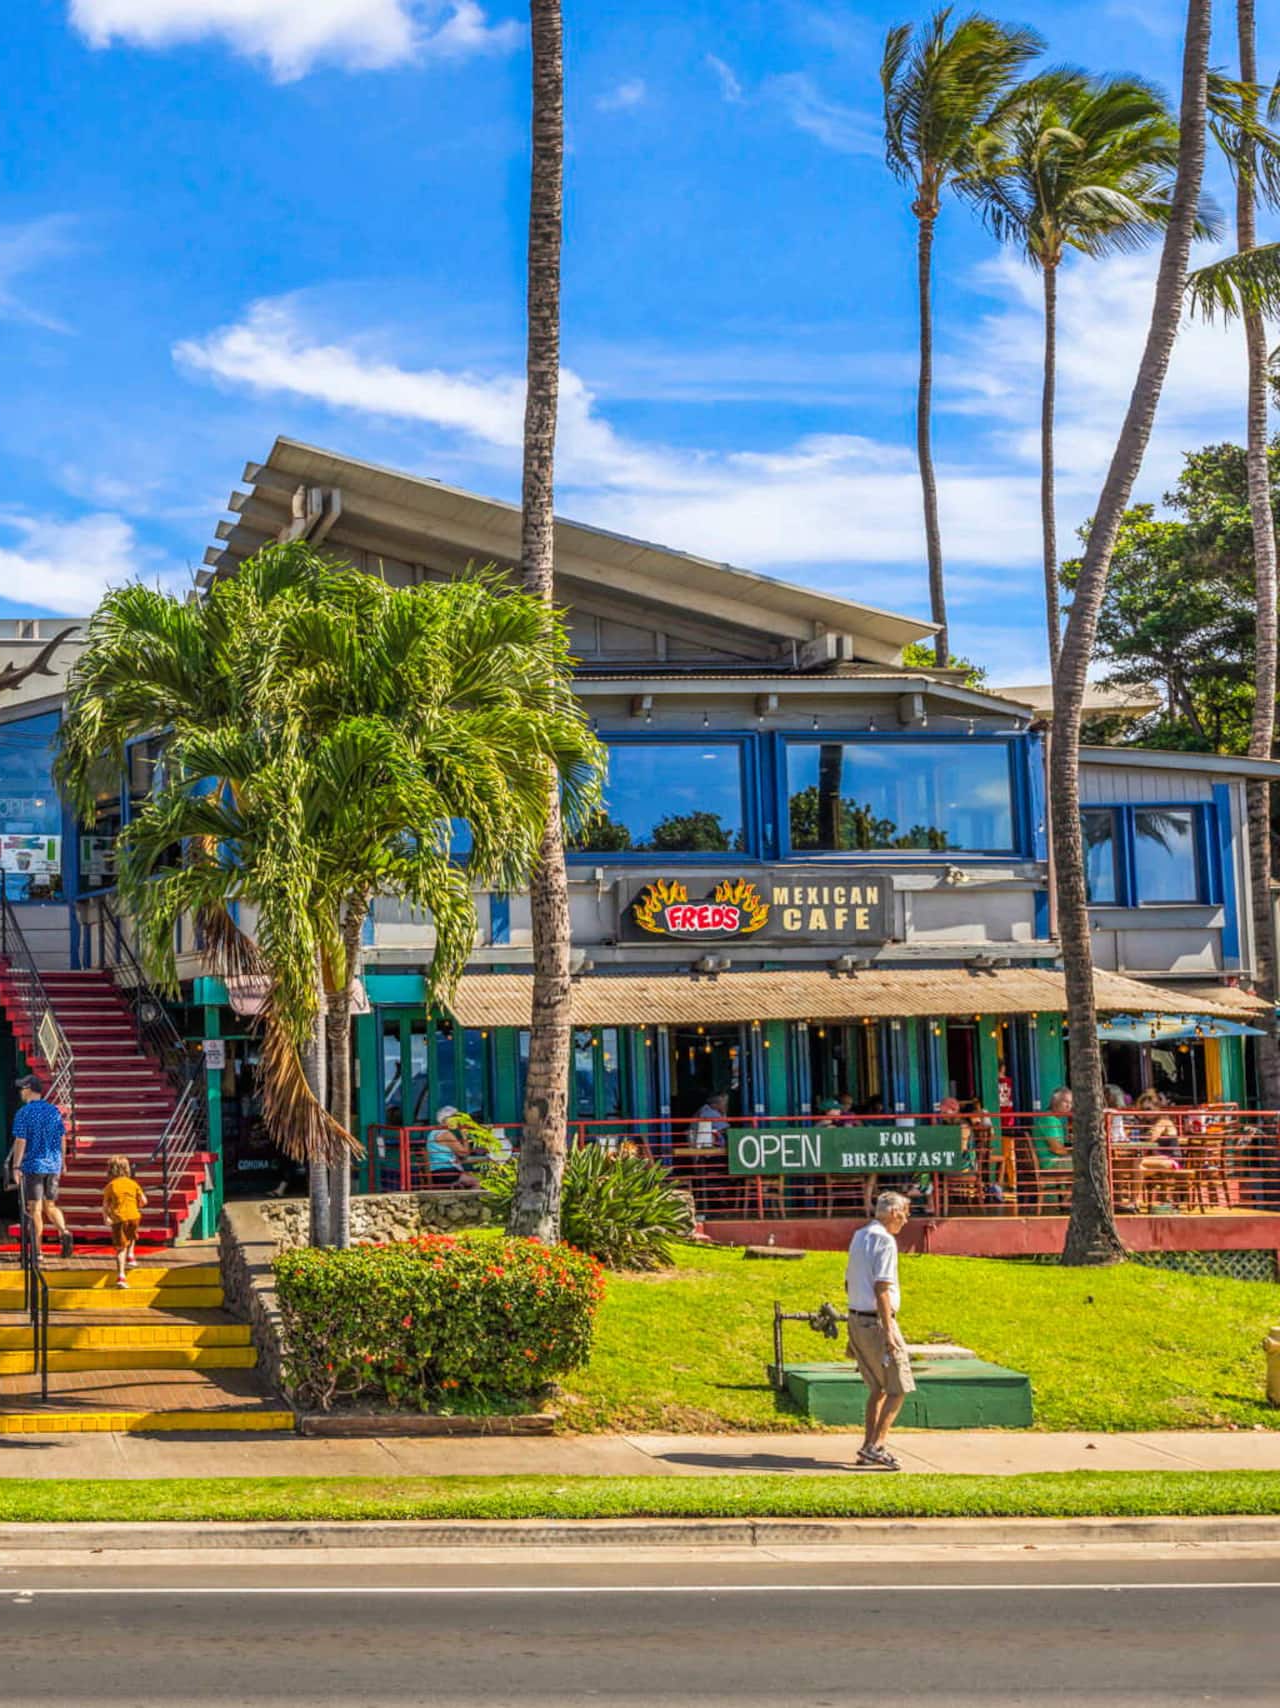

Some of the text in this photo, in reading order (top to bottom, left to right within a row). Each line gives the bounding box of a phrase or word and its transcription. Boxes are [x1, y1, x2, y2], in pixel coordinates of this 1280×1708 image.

[772, 886, 879, 905] MEXICAN
[665, 905, 740, 932] FRED'S
[782, 907, 871, 931] CAFE
[737, 1131, 916, 1169] OPEN FOR
[840, 1151, 956, 1168] BREAKFAST
